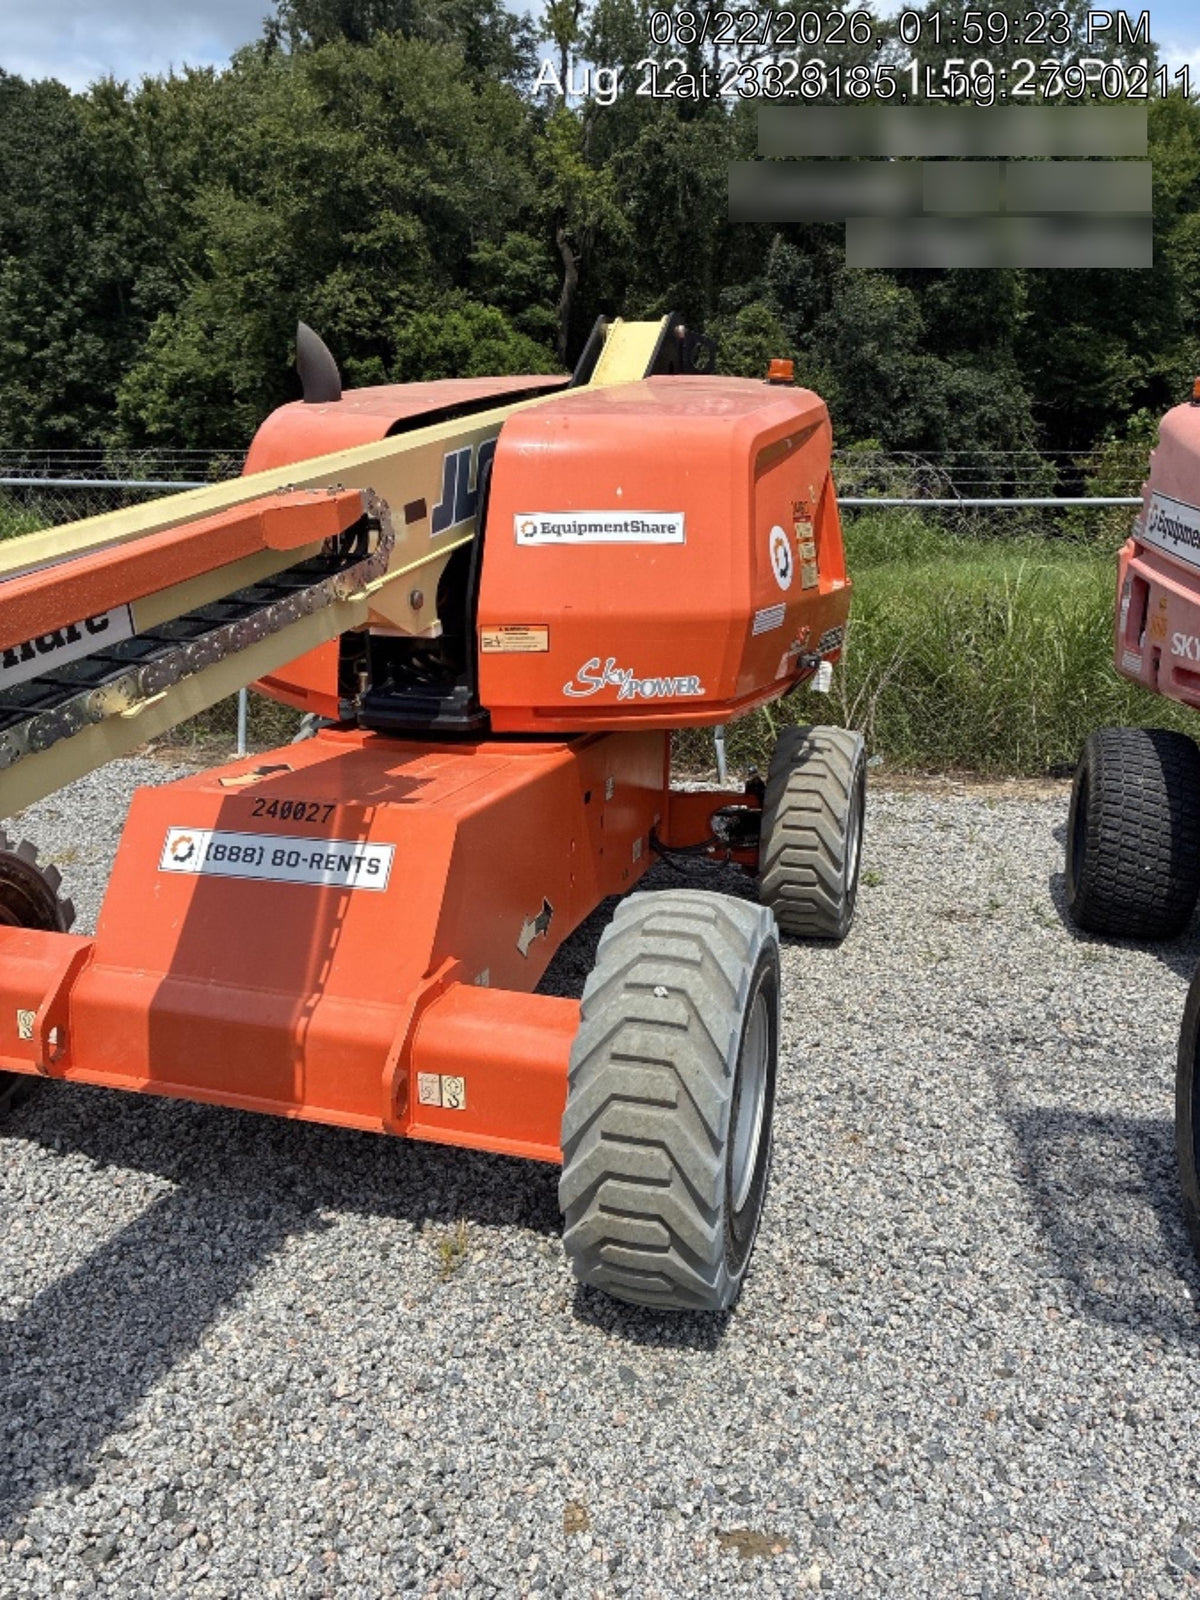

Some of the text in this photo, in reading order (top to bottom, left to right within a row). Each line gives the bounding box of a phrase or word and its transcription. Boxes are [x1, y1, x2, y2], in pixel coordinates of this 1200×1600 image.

[540, 520, 677, 537] EquipmentShare
[251, 798, 336, 824] 240027
[205, 842, 382, 875] (888) 80-RENTS
